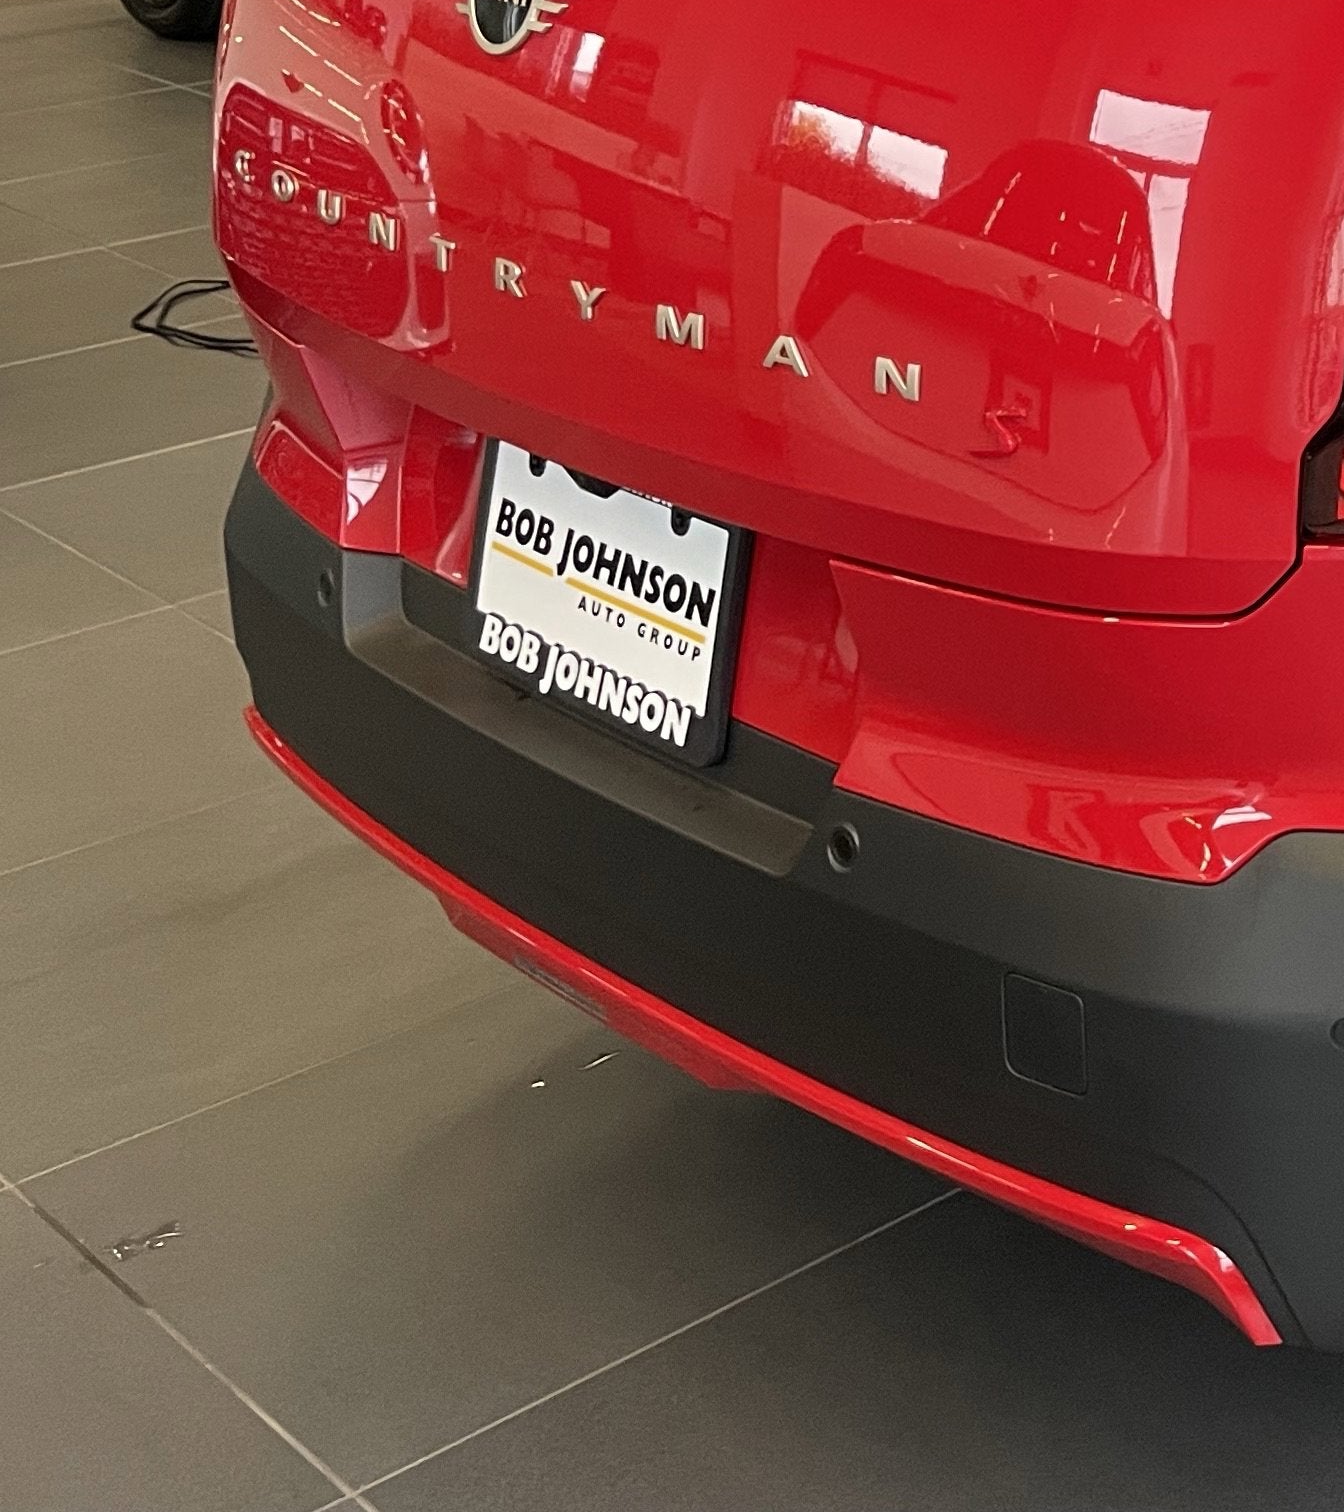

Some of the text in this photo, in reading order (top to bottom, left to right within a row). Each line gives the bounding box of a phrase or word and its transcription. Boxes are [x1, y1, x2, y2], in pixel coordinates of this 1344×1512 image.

[231, 148, 924, 403] COUNTRYMAN
[495, 497, 717, 628] BOB JOHNSON
[577, 595, 702, 662] AUTO GROUP
[478, 613, 692, 748] BOB JOHNSON
